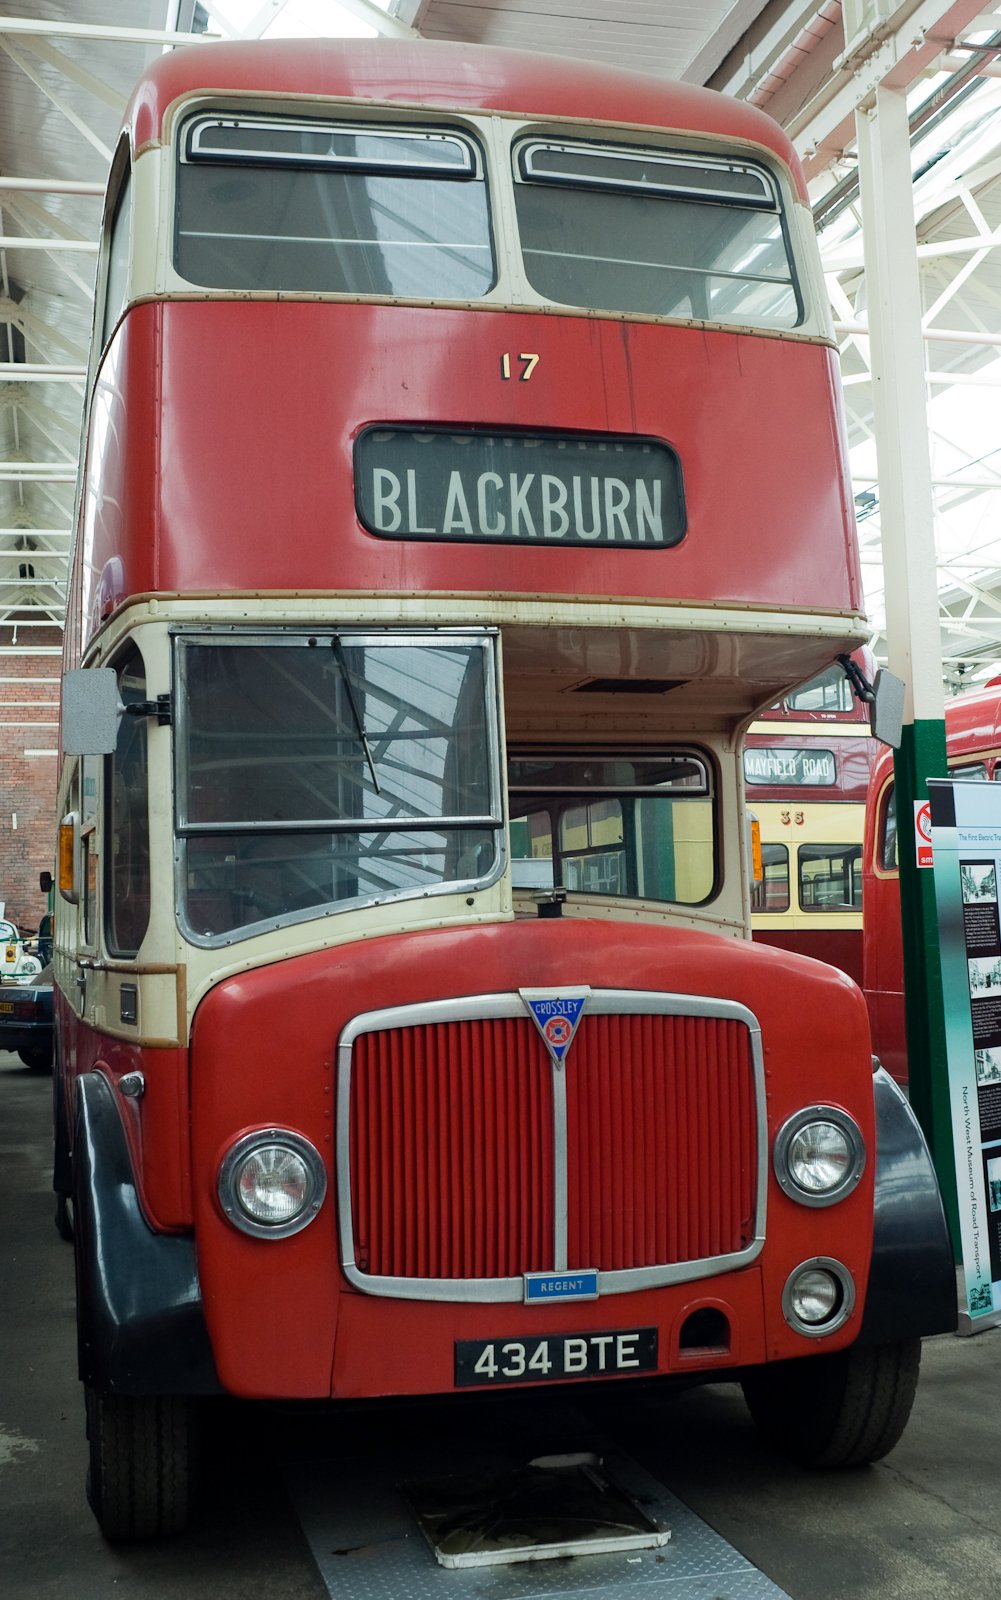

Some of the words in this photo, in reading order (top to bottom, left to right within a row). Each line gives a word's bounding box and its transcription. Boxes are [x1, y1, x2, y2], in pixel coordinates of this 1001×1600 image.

[501, 353, 540, 381] 17
[372, 467, 664, 541] BLACKBURN
[746, 758, 797, 776] MAYFIELD
[803, 758, 829, 777] ROAD
[958, 833, 967, 841] The
[968, 833, 978, 841] First
[978, 833, 994, 841] Electric
[535, 1001, 578, 1015] CROSSLEY
[966, 1146, 974, 1190] Museum
[969, 1191, 977, 1201] of
[971, 1203, 979, 1230] Road
[973, 1230, 982, 1280] Transport
[540, 1280, 584, 1293] REGENT
[474, 1341, 552, 1378] 434
[564, 1334, 640, 1373] BTE
